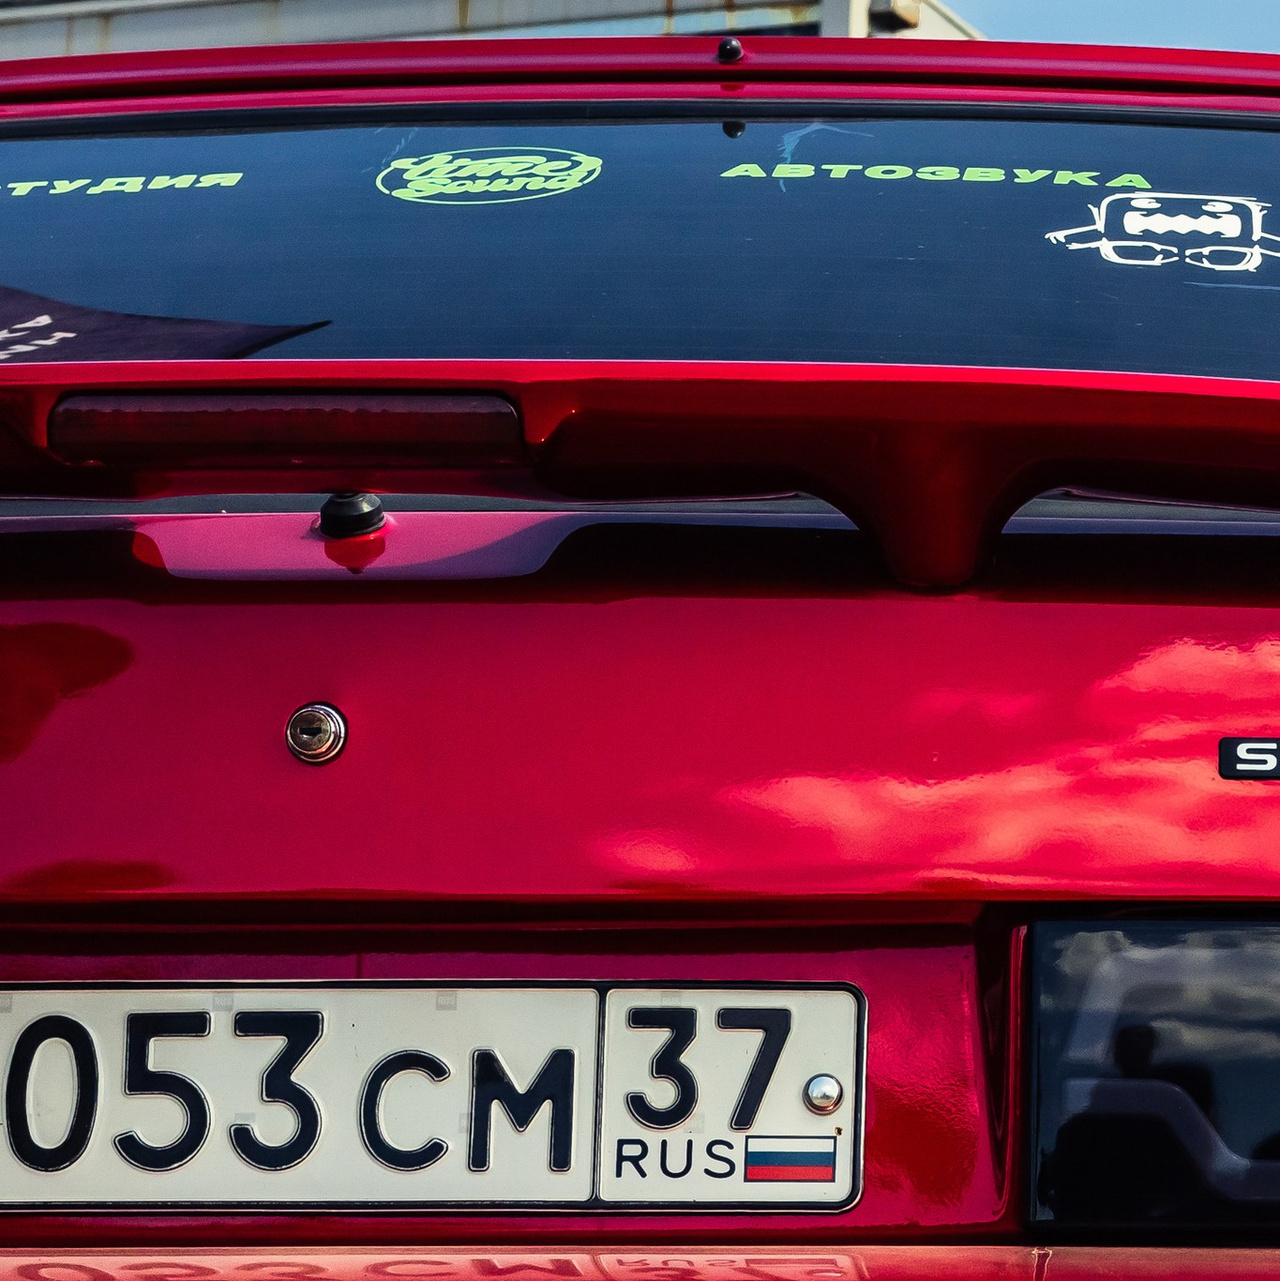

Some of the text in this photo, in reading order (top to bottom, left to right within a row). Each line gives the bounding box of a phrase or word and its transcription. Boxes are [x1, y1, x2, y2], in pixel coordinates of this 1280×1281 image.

[0, 173, 244, 196] ТУДИЯ
[719, 163, 1152, 189] АВТОЗВУКА
[625, 1007, 792, 1131] 37
[615, 1138, 736, 1179] RUS
